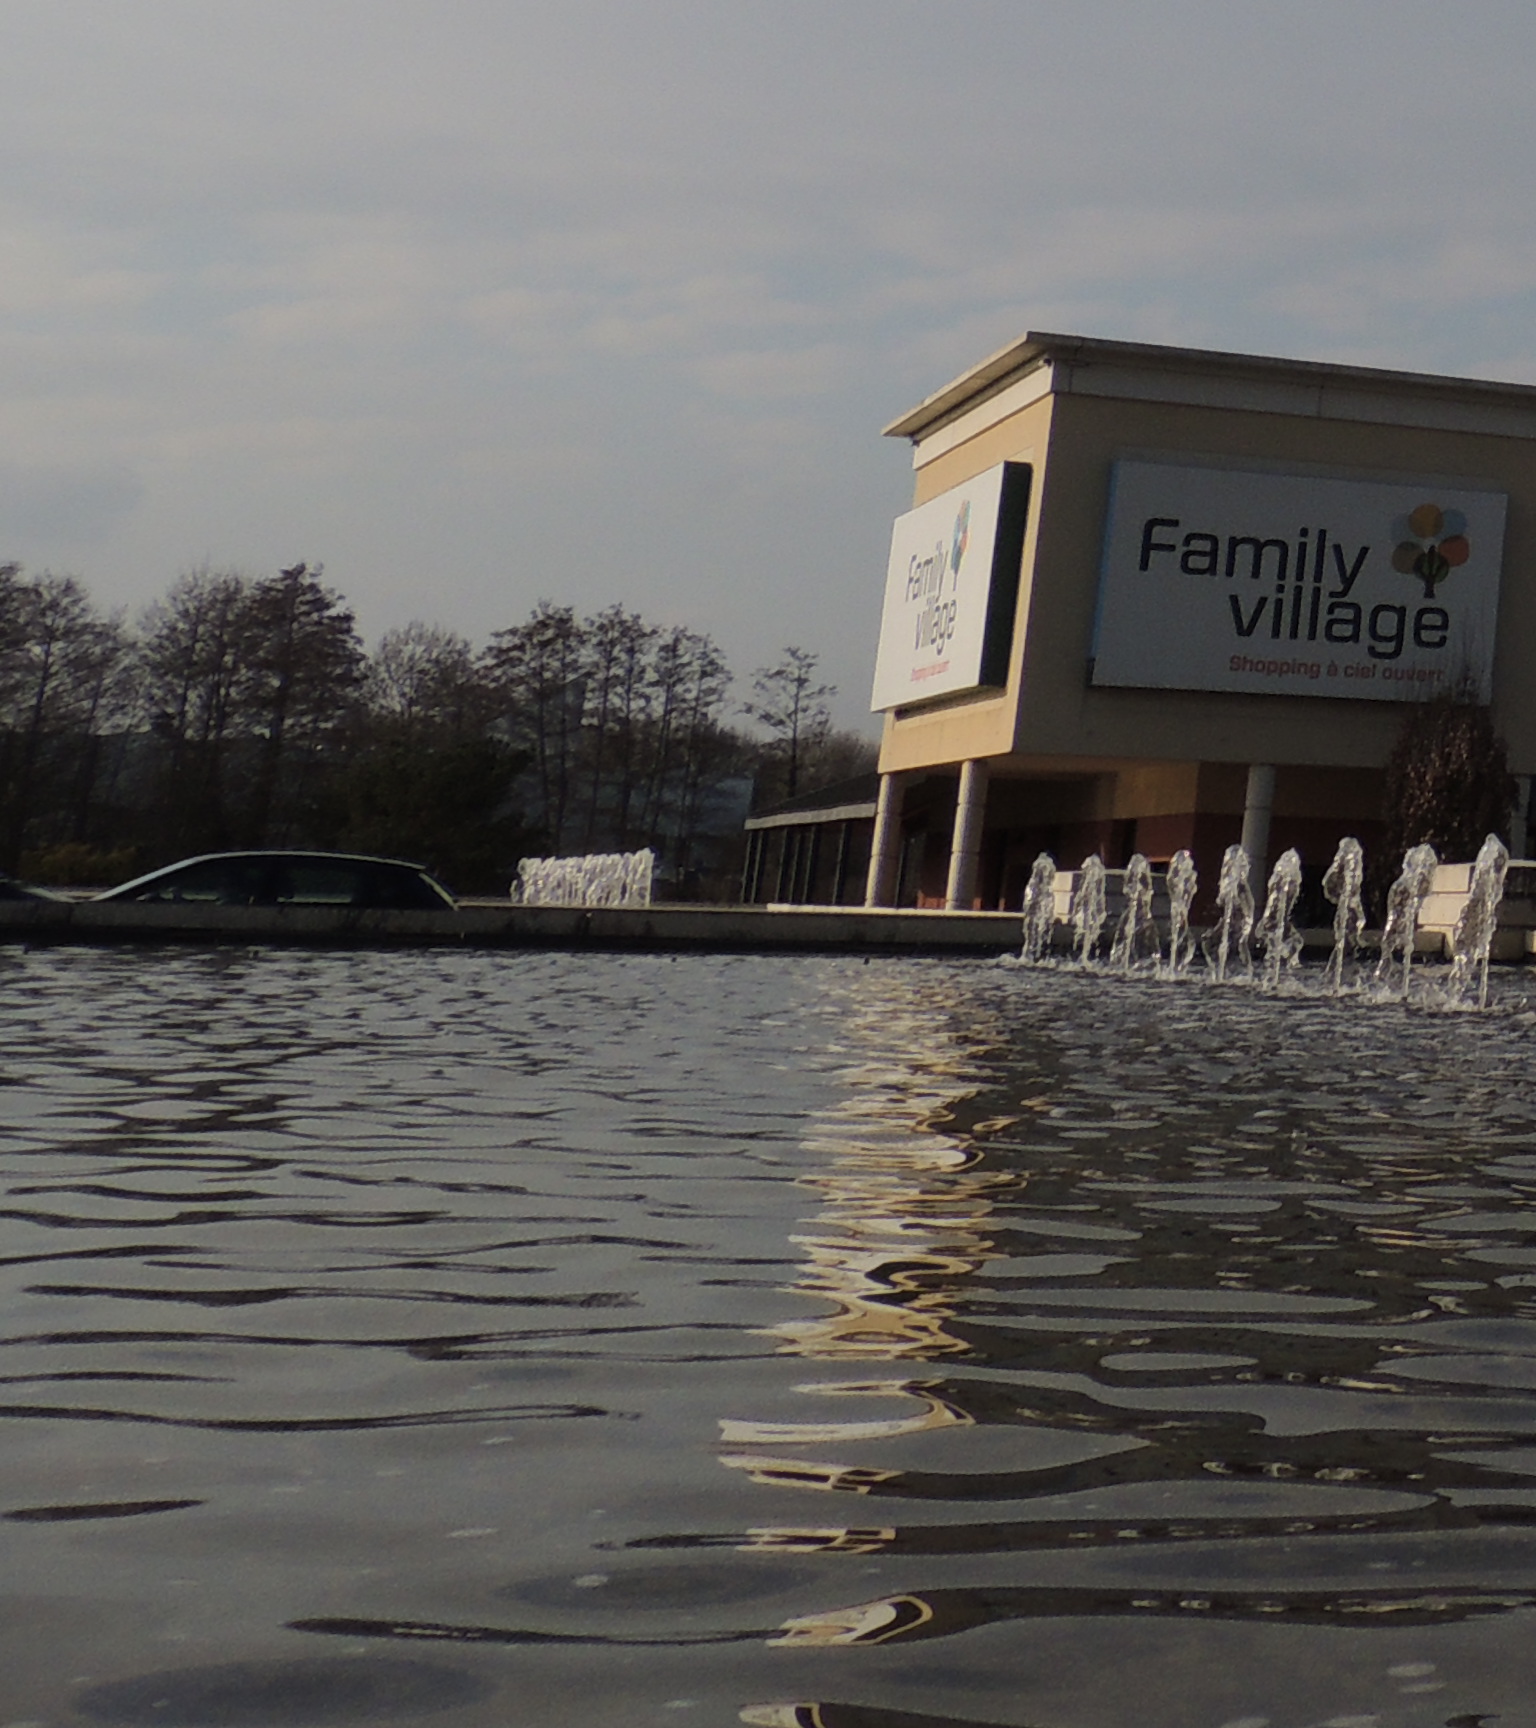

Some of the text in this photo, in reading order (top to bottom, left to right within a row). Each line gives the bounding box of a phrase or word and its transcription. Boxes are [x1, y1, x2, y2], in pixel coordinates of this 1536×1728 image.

[1138, 516, 1370, 599] Family
[1228, 585, 1450, 660] village
[1229, 654, 1321, 680] Shopping
[1326, 660, 1338, 677] à
[1343, 662, 1377, 678] ciel
